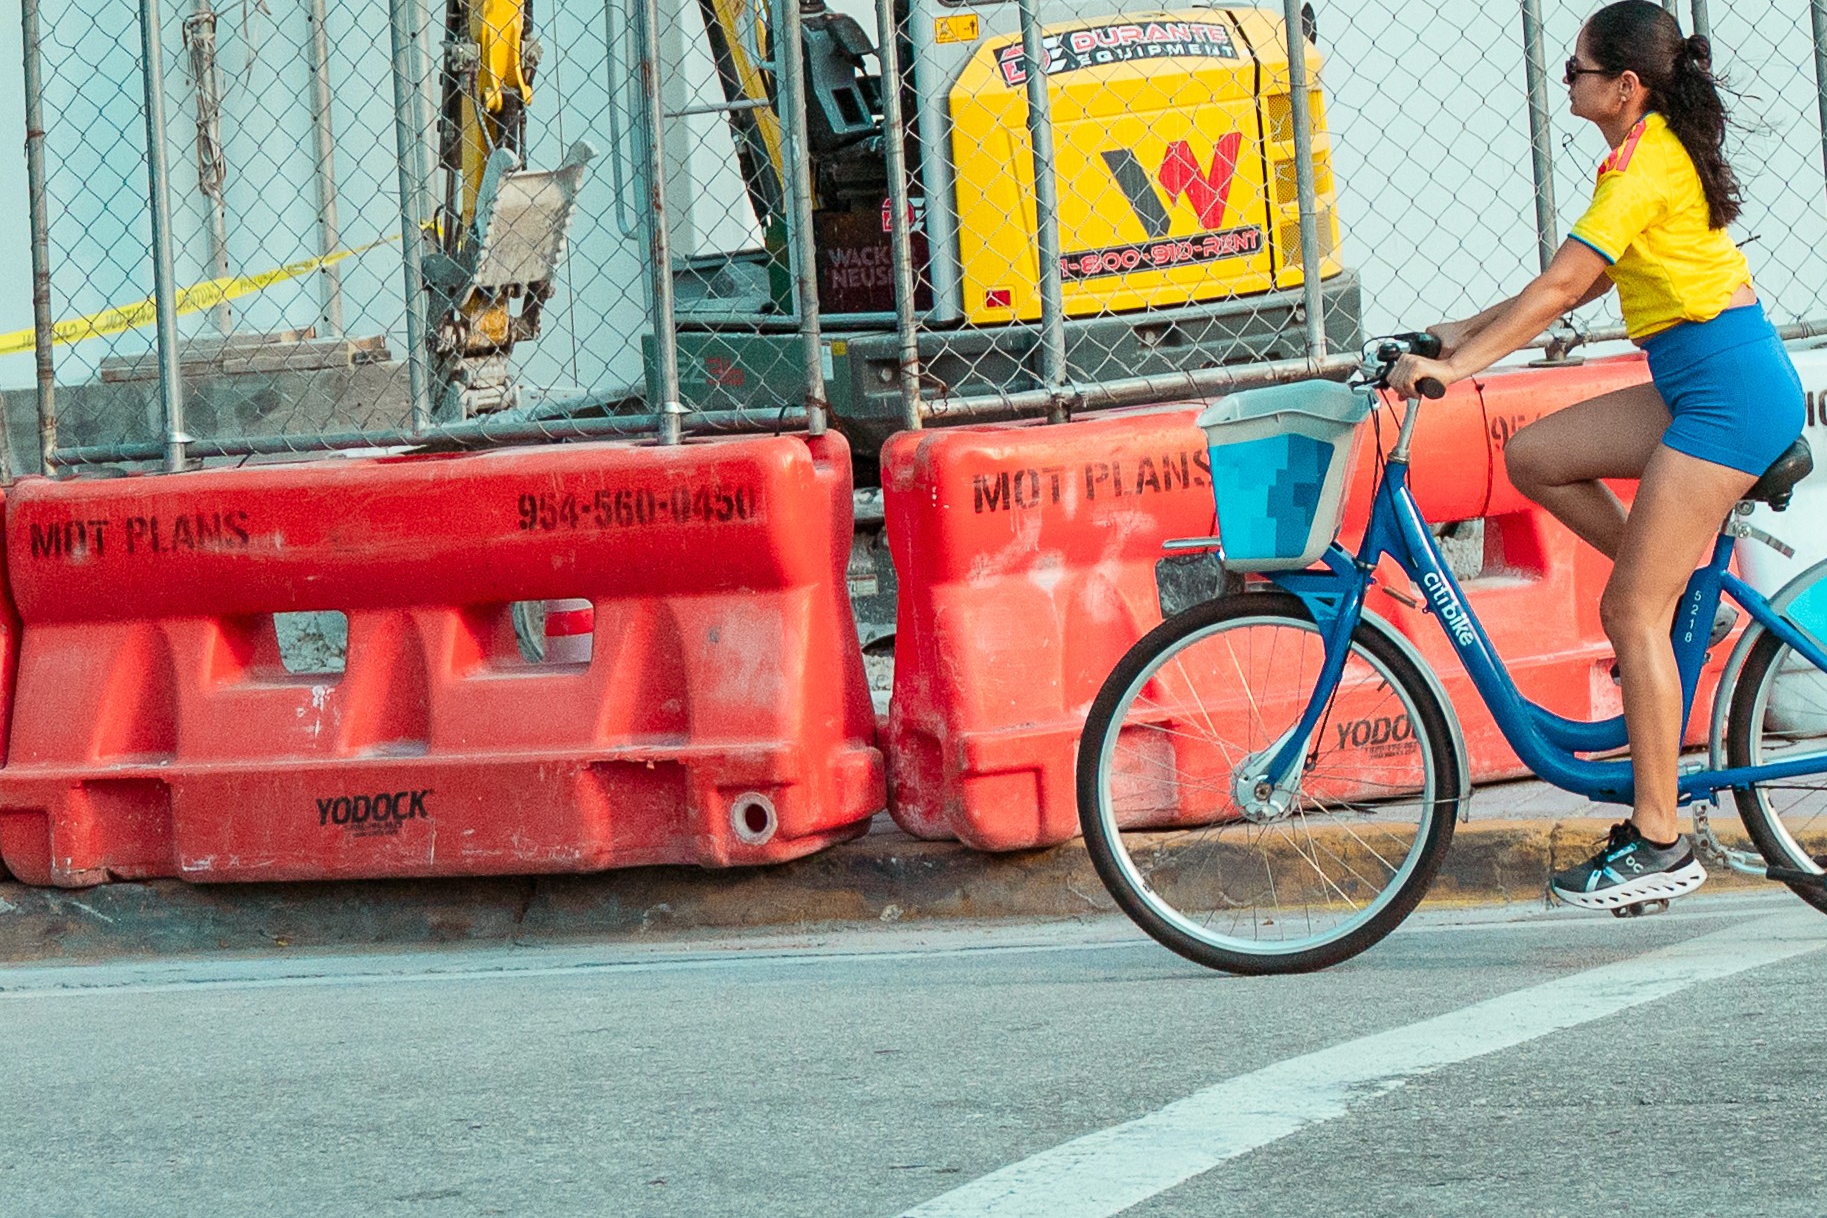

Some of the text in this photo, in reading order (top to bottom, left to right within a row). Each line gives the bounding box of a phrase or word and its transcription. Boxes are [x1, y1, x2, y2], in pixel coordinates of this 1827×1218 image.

[1070, 24, 1229, 53] DURANTE
[1078, 43, 1235, 66] EQUIPMENT
[973, 449, 1213, 513] MOT PLANS
[518, 484, 756, 530] 954-560-0450
[30, 510, 250, 559] MOT PLANS
[1685, 590, 1702, 642] 5218
[316, 789, 430, 825] YODOCK
